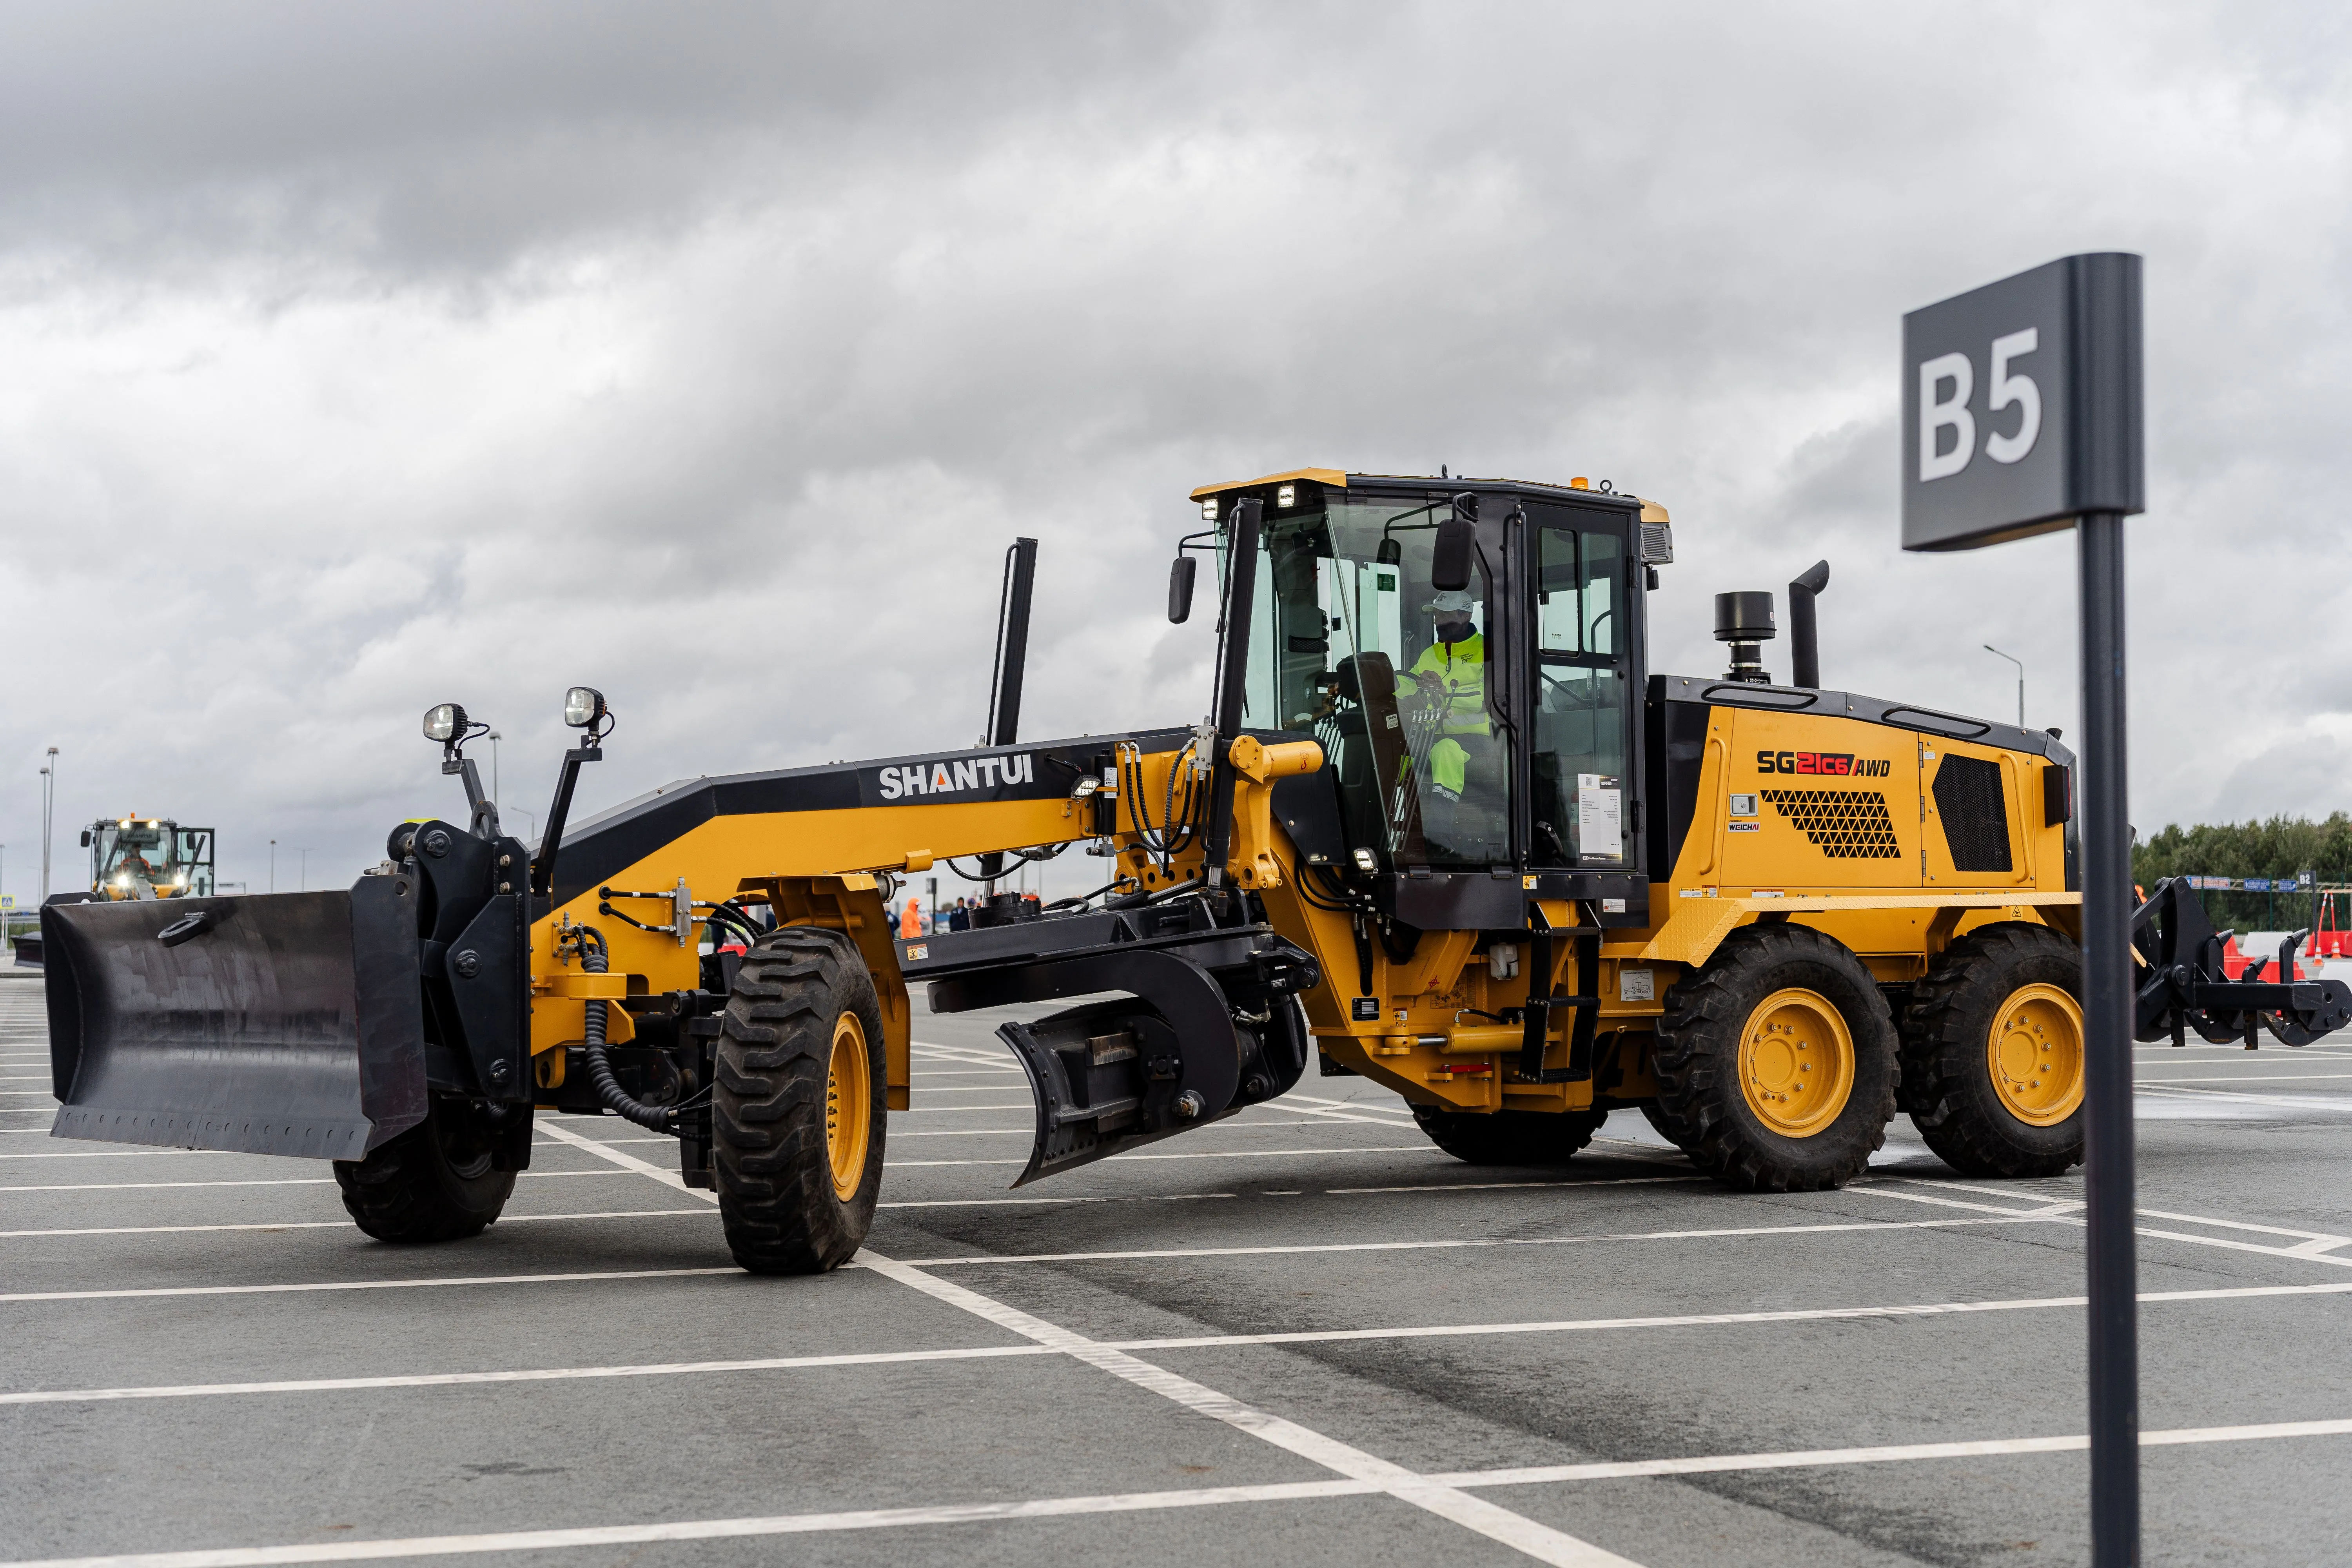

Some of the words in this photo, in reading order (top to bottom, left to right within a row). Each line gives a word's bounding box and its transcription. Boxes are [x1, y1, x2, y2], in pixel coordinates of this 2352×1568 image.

[1920, 326, 2042, 482] B5
[880, 754, 1033, 799] SHANTUI
[2299, 874, 2310, 884] B2
